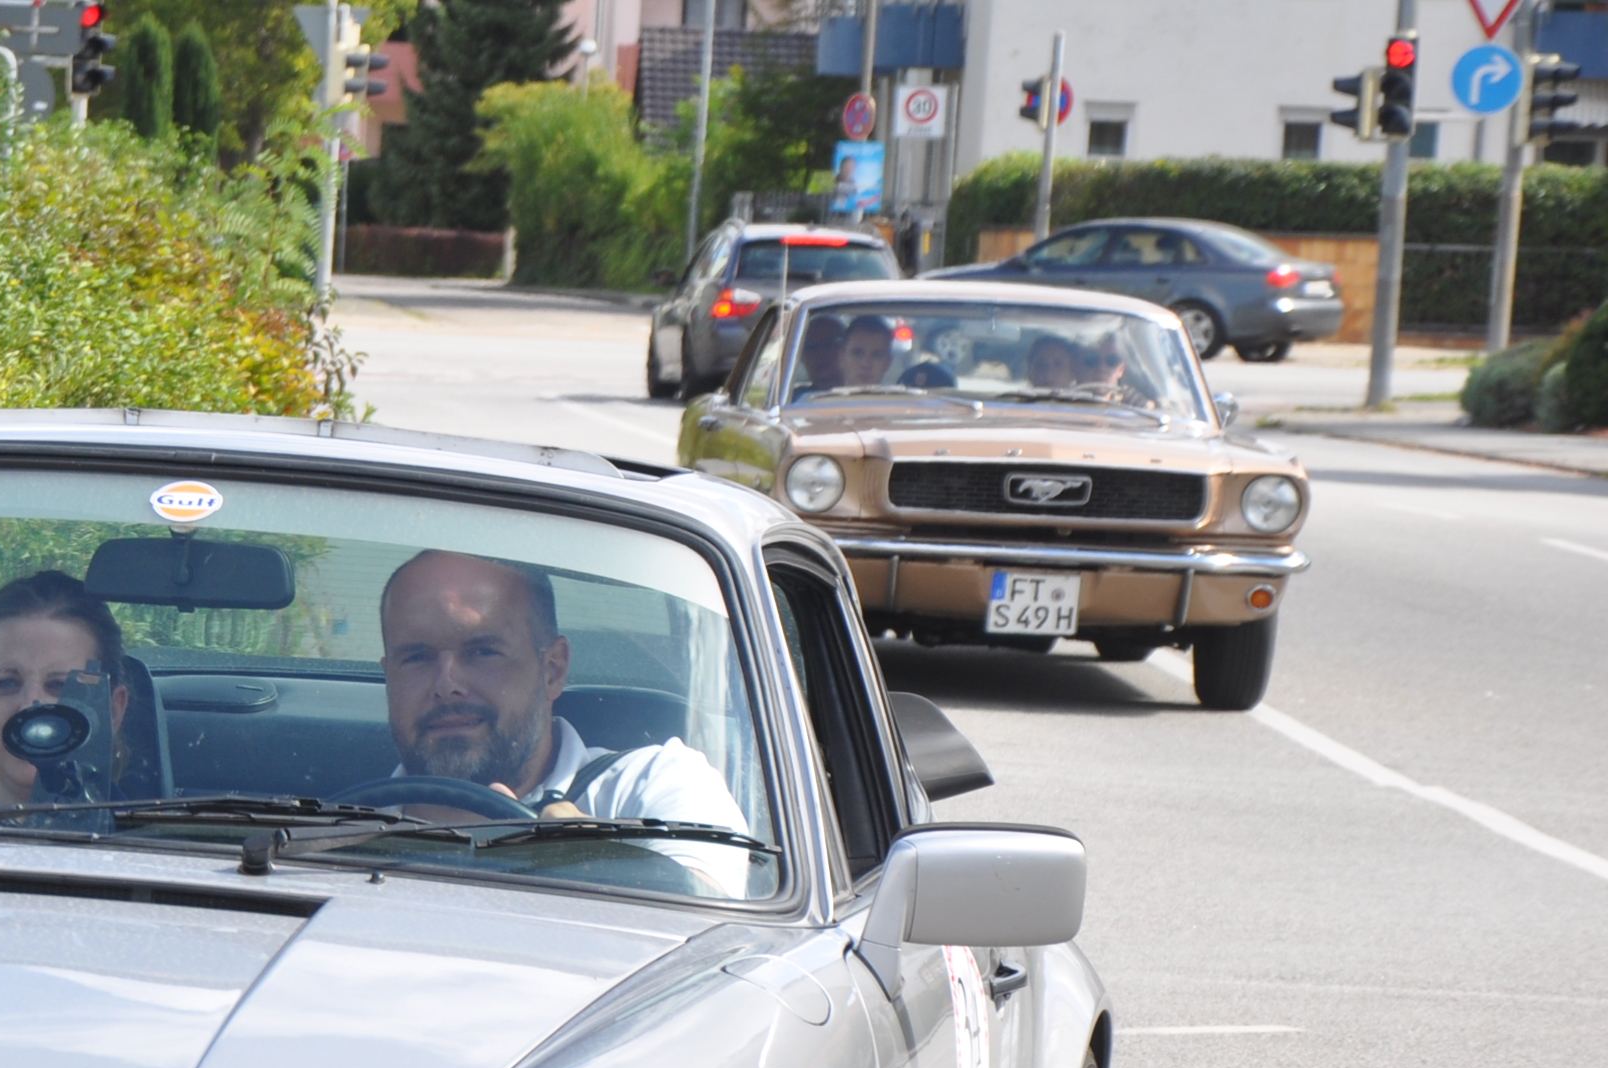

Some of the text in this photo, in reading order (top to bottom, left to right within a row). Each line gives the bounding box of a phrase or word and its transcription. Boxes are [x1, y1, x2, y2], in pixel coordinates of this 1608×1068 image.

[912, 97, 933, 117] 30
[156, 494, 218, 508] Gulf
[1010, 578, 1047, 602] FT
